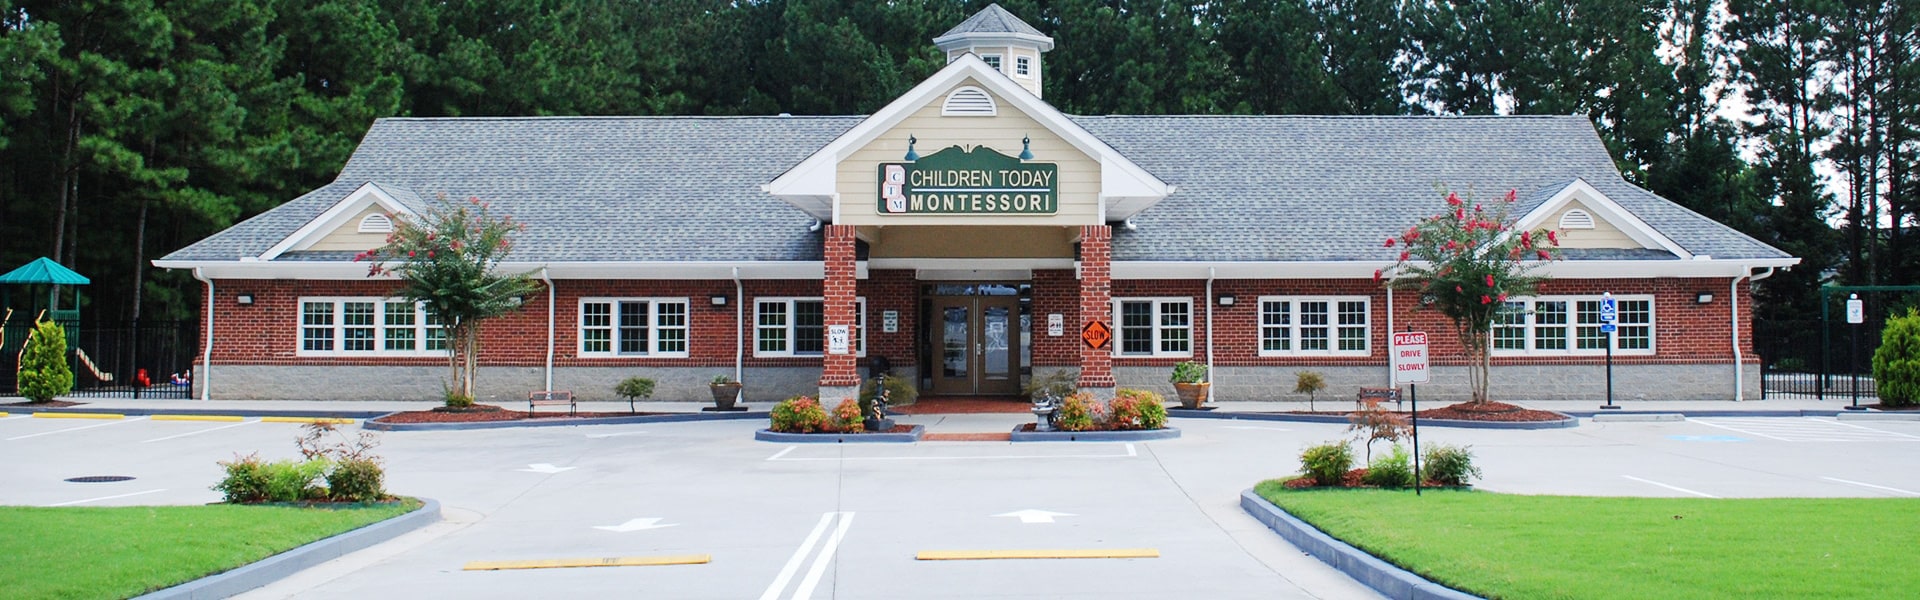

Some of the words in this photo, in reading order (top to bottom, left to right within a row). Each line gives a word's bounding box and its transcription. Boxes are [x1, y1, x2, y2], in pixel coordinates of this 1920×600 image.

[910, 170, 992, 187] CHILDREN
[999, 170, 1053, 187] TODAY
[910, 194, 1049, 211] MONTESSORI
[1086, 330, 1105, 340] SLOW
[1395, 335, 1425, 344] PLEASE
[1398, 363, 1425, 371] SLOWLY
